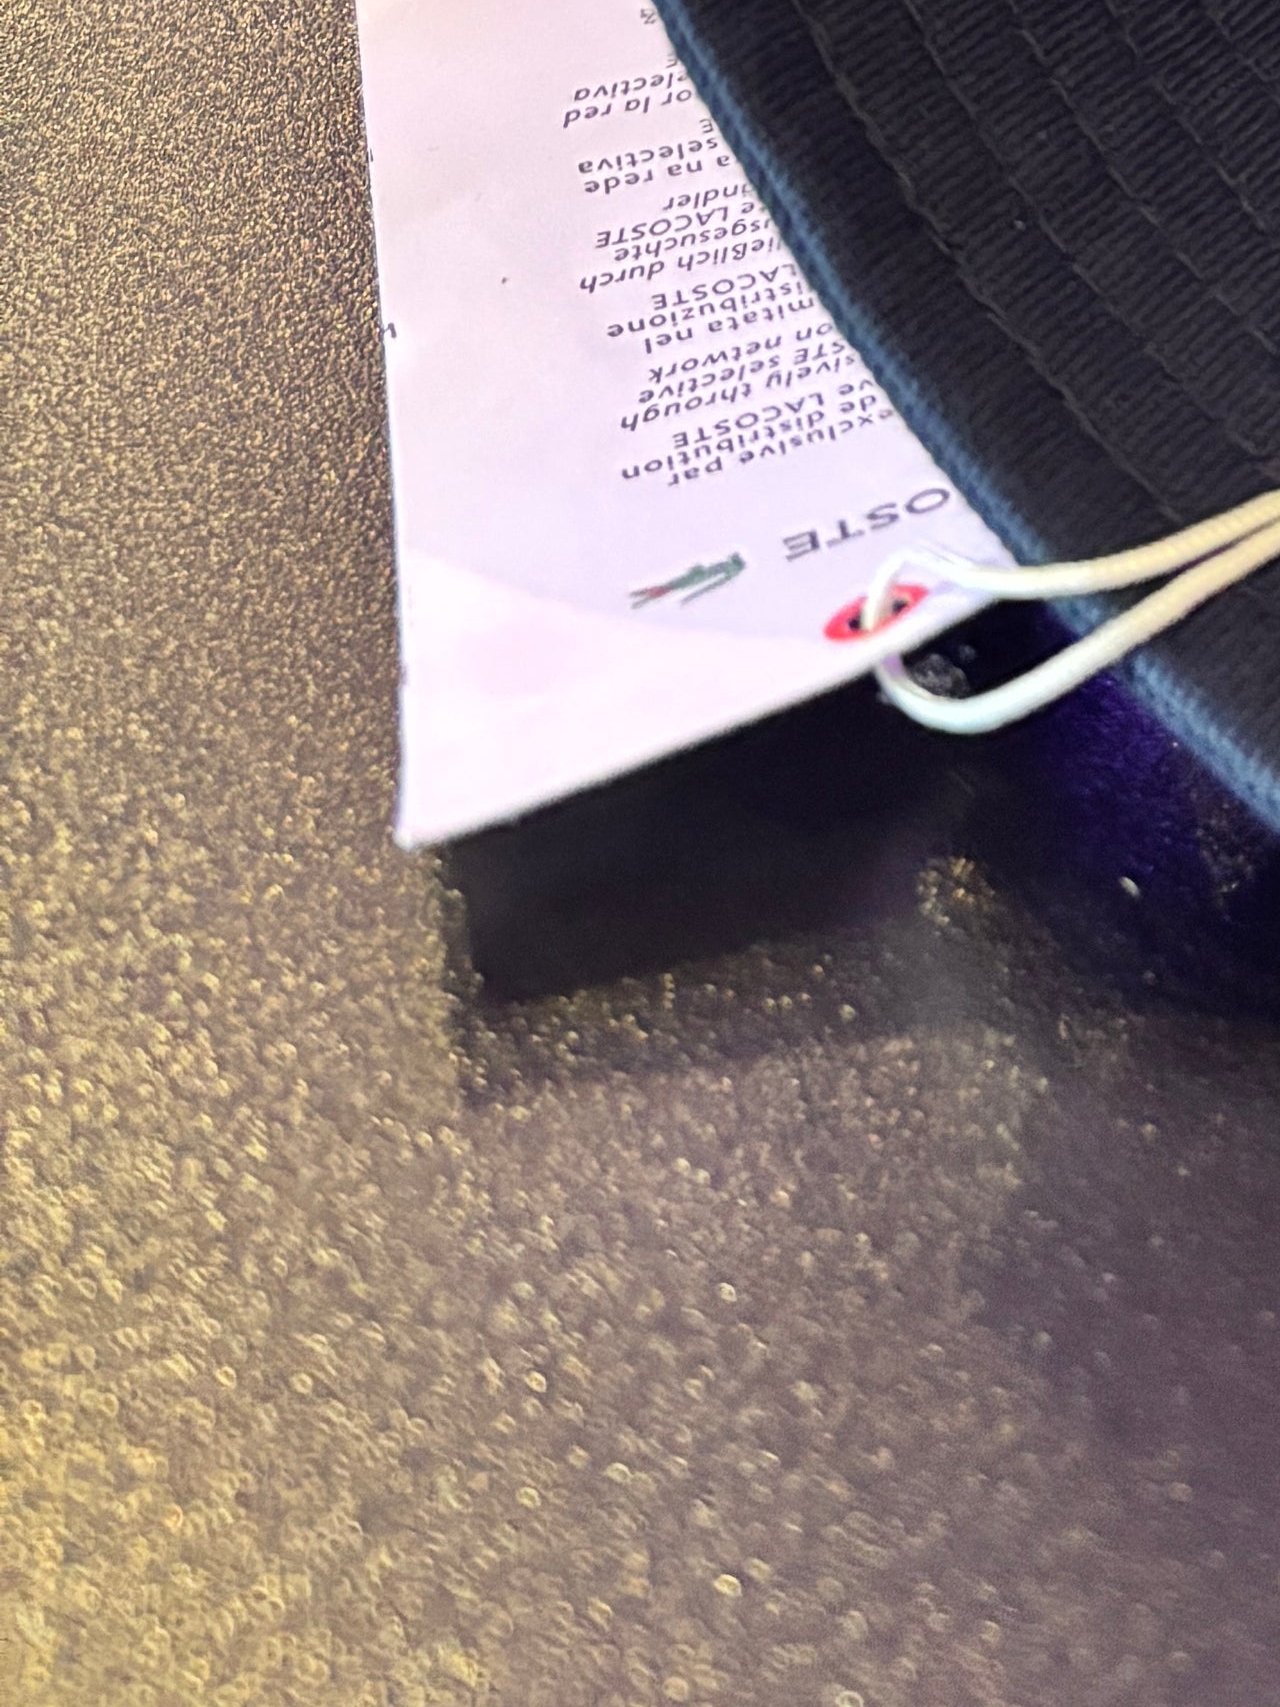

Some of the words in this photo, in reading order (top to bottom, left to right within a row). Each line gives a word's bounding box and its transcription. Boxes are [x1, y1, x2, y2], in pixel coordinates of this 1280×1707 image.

[562, 103, 611, 128] red
[624, 96, 650, 113] la
[577, 137, 718, 174] selectiva
[666, 159, 702, 176] na
[584, 169, 653, 194] rede
[595, 205, 728, 248] LACOSTE
[579, 260, 665, 294] durch
[644, 327, 692, 354] nel
[648, 335, 781, 384] network
[637, 354, 779, 403] selective
[620, 382, 751, 432] through
[672, 392, 824, 448] LACOSTE
[621, 410, 824, 479] distribution
[668, 455, 723, 486] par
